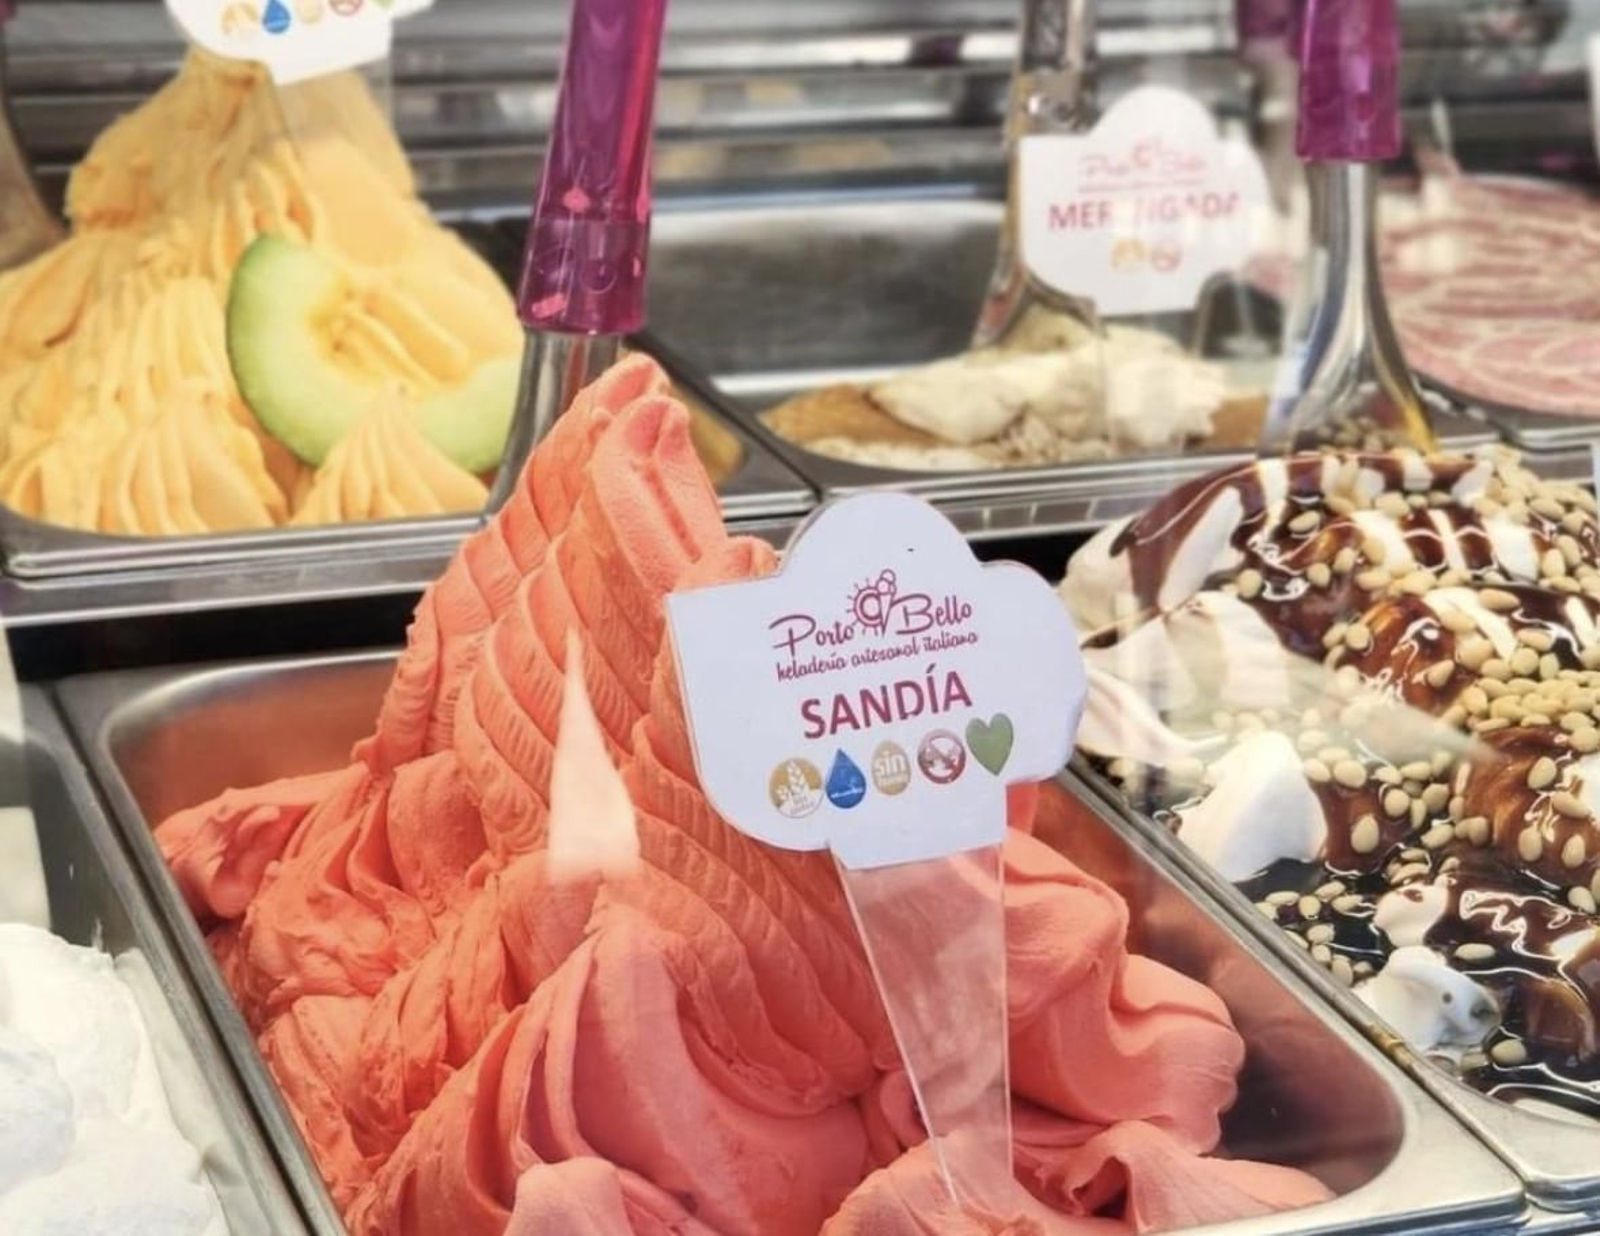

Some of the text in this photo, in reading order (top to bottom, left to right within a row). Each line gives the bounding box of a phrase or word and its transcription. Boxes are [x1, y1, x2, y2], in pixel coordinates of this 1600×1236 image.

[769, 593, 972, 657] Porto Bello
[776, 631, 979, 682] heladería artesanal italiana
[801, 663, 973, 740] SANDÍA
[874, 750, 906, 776] sin
